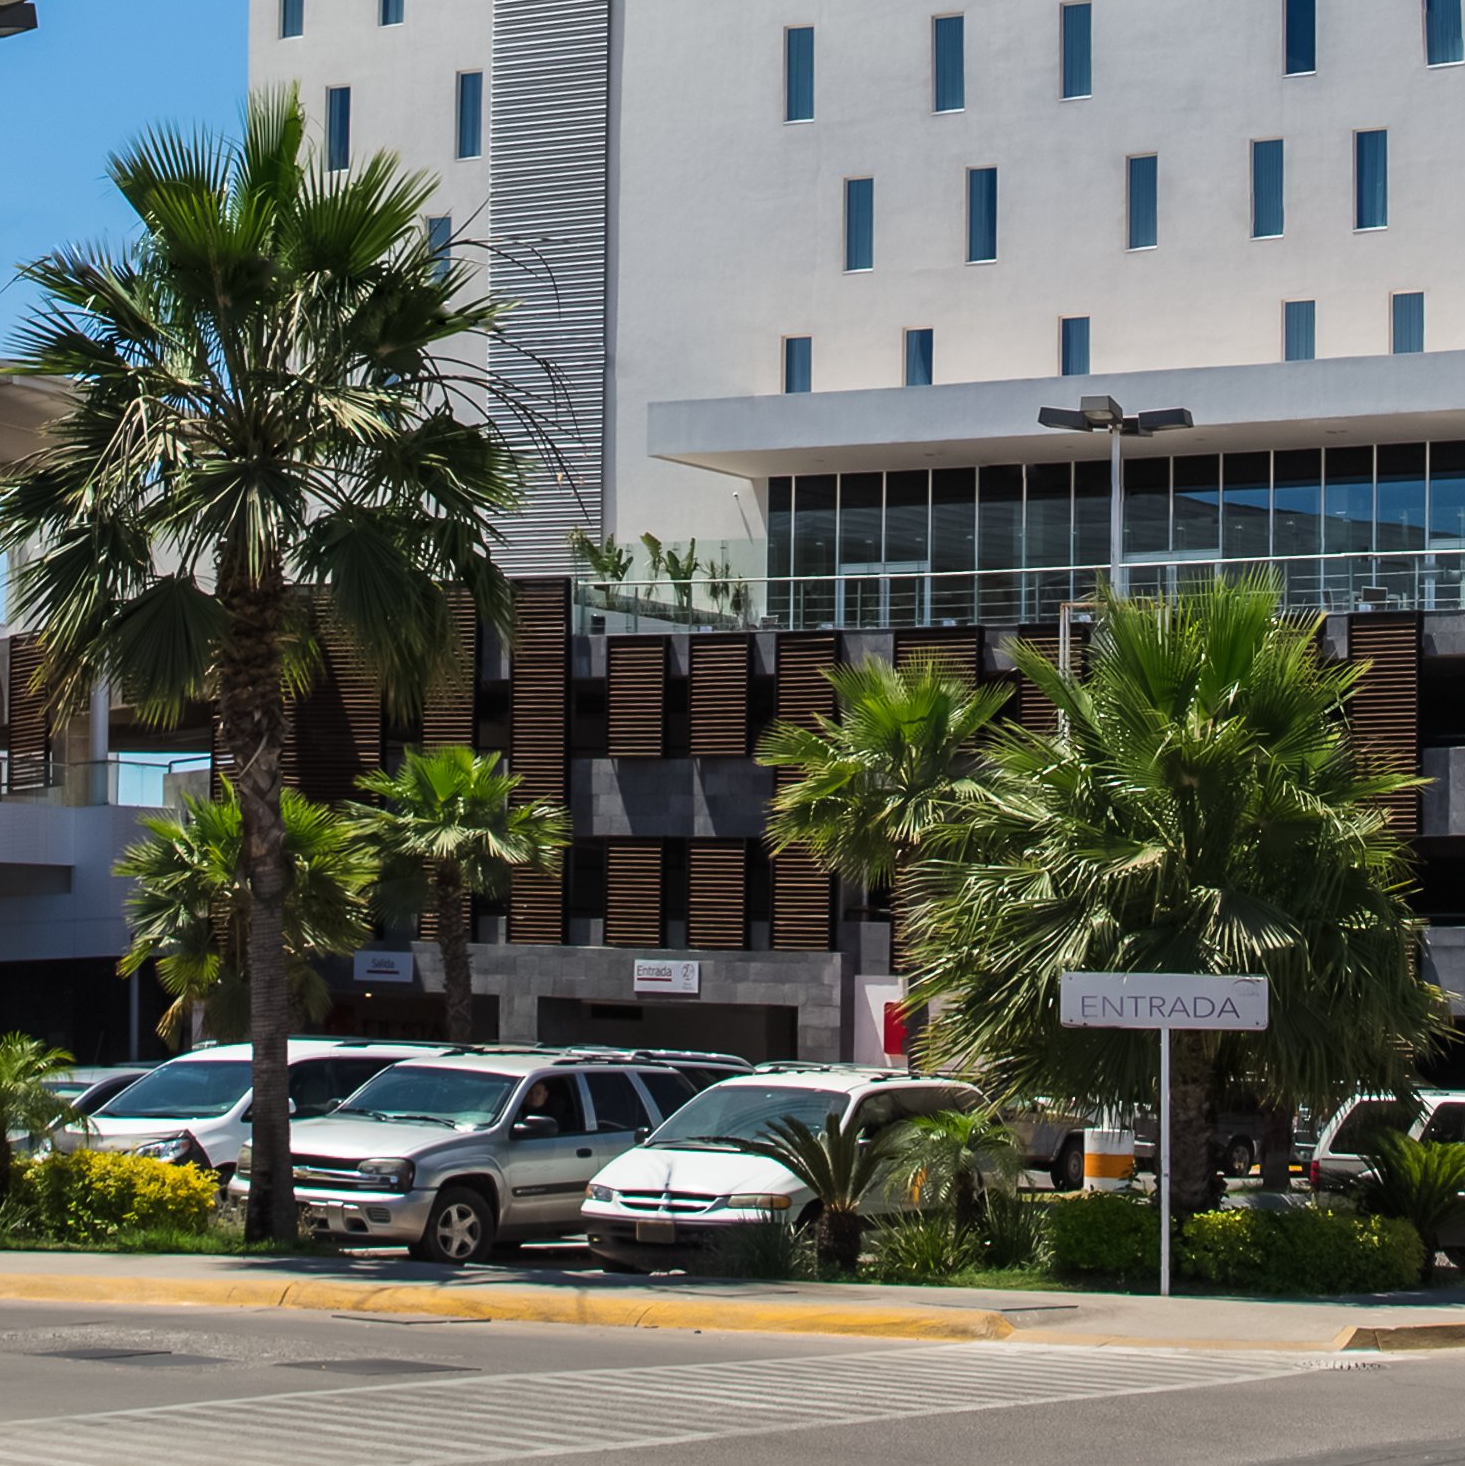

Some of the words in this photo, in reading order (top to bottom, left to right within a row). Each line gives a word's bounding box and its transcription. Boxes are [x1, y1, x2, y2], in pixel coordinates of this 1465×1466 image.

[371, 957, 396, 969] Salida
[637, 965, 672, 977] Entrada
[1081, 995, 1240, 1019] ENTRADA
